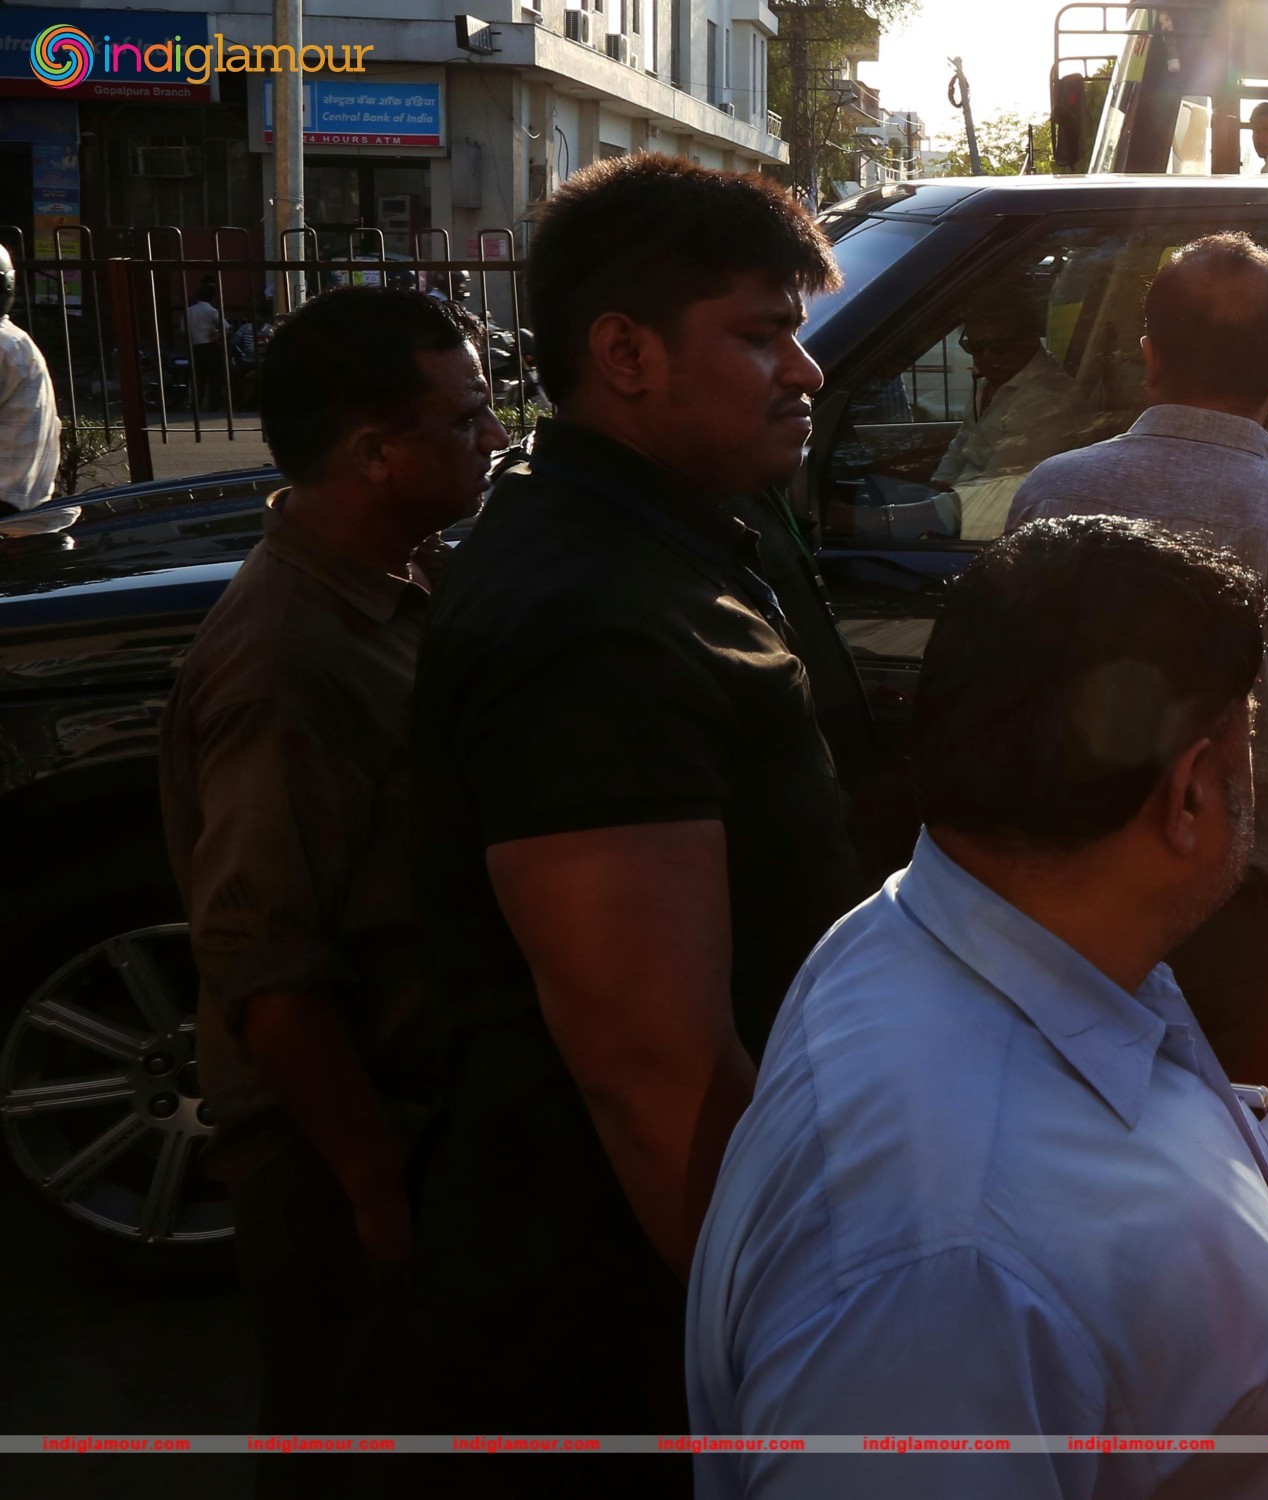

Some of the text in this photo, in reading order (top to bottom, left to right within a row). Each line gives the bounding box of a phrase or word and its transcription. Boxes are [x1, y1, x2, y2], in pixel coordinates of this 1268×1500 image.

[94, 86, 191, 98] Gopalpura Branch
[357, 94, 376, 105] बैंक
[404, 95, 436, 107] इंडिया
[322, 111, 433, 124] Central Bank of India
[322, 135, 368, 144] HOURS
[375, 136, 401, 144] ATM
